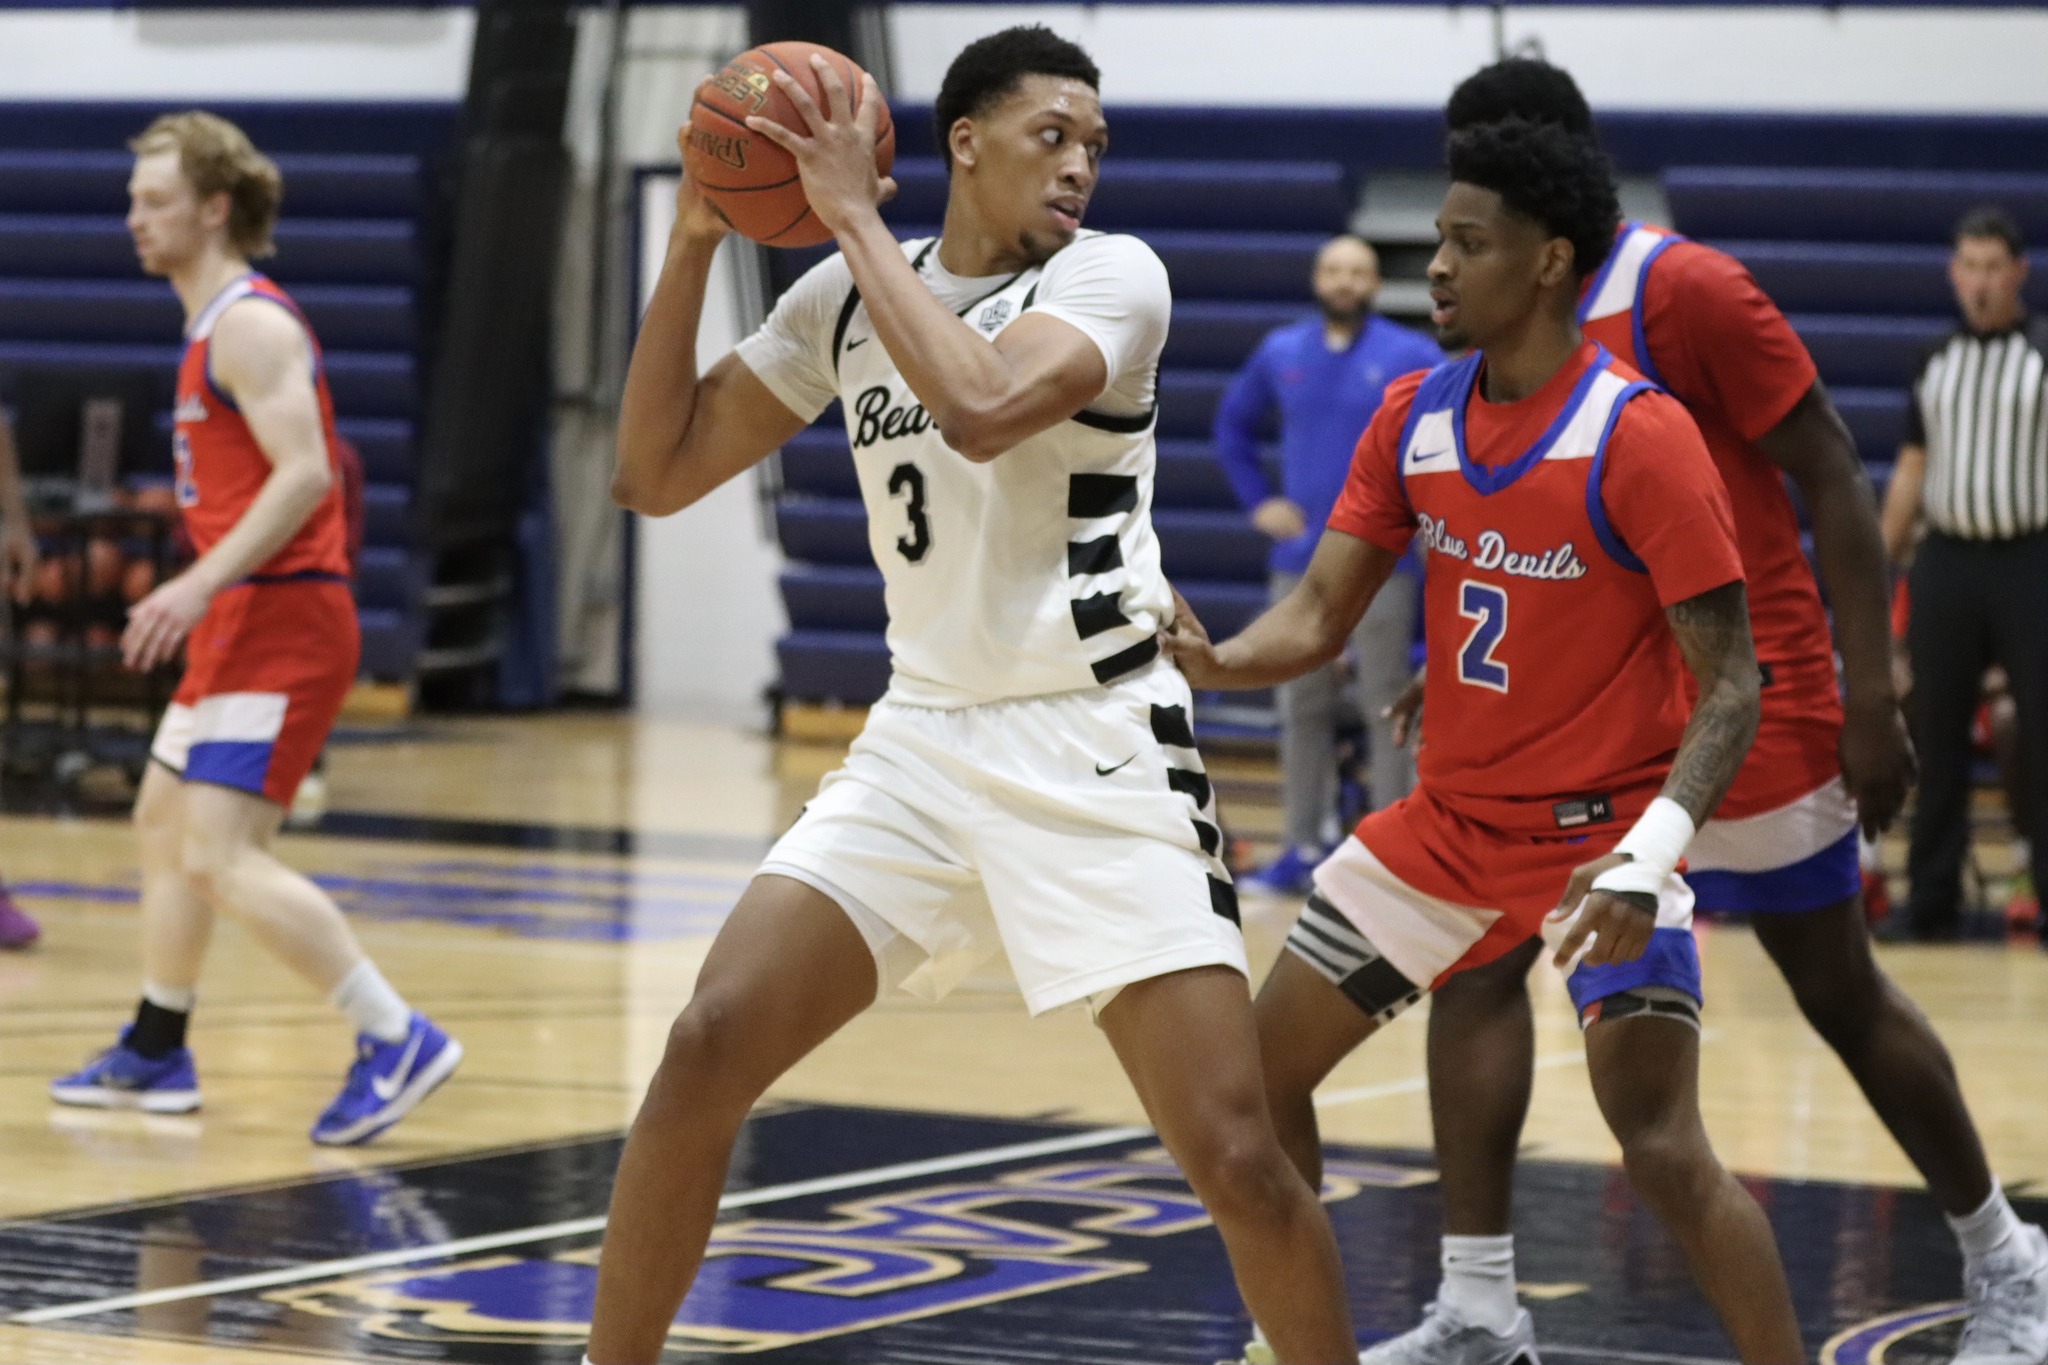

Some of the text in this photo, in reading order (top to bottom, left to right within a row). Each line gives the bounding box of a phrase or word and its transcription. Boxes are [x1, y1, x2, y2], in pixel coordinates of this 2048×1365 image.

[853, 384, 940, 449] Bea
[887, 461, 934, 565] 3
[1472, 530, 1587, 579] Devils
[1457, 579, 1508, 694] 2
